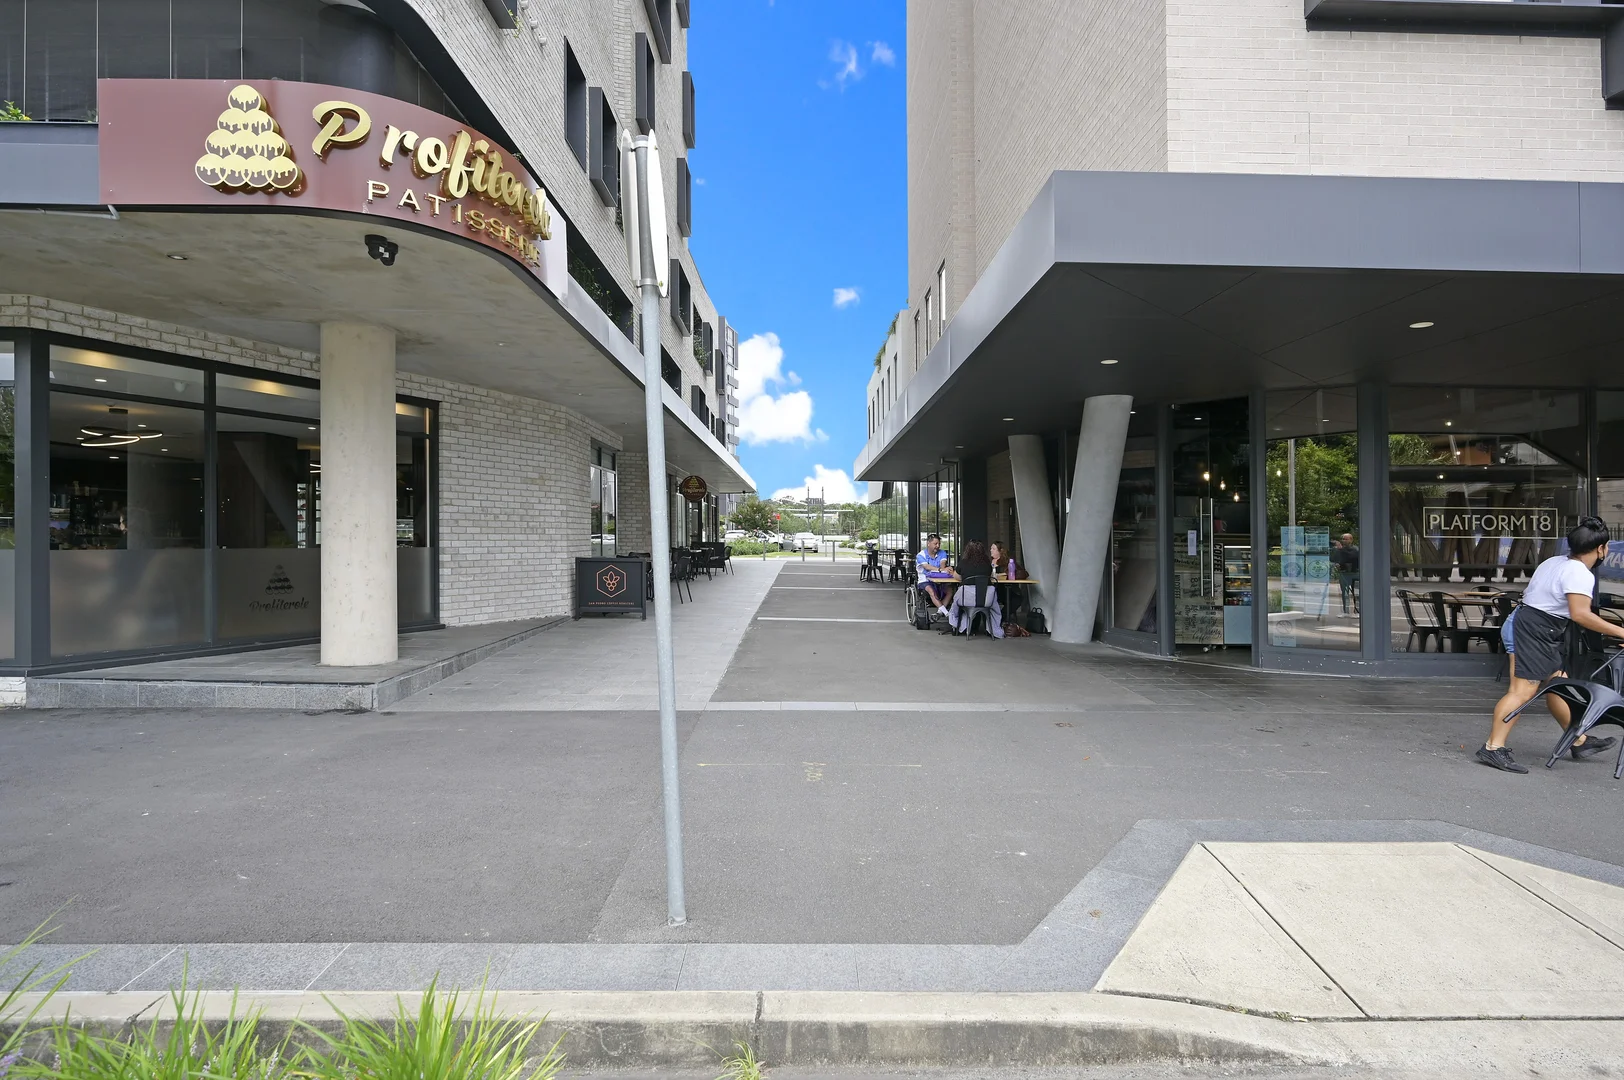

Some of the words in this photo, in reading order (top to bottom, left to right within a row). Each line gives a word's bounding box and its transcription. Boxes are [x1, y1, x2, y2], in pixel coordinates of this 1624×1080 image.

[367, 179, 541, 268] PATISSERIE
[1429, 514, 1526, 531] PLATFORM
[1530, 515, 1552, 532] T8
[1214, 544, 1223, 573] COFFEE
[249, 597, 310, 612] Profiterole
